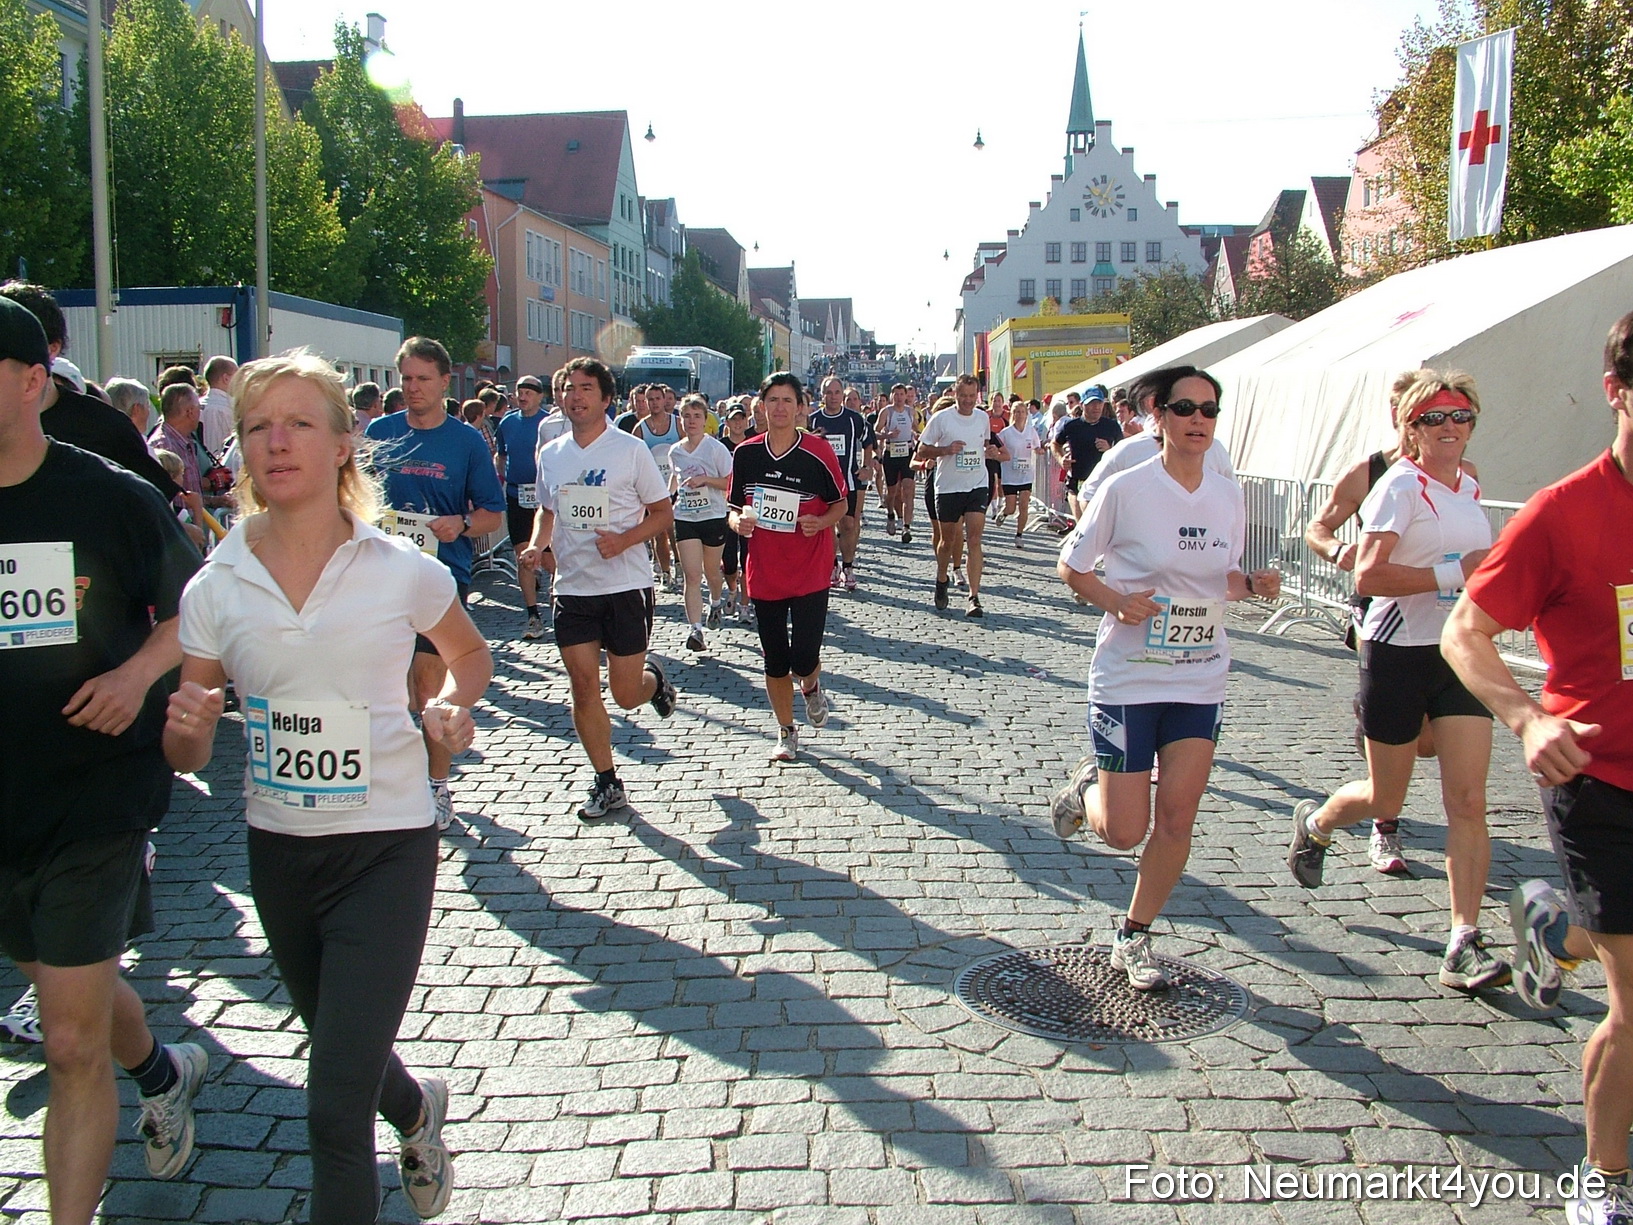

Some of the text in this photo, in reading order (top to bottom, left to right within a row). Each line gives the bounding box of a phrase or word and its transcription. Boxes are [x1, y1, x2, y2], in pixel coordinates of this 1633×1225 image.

[687, 498, 709, 508] 2323
[764, 493, 778, 502] Irmi
[571, 505, 603, 518] 3601
[763, 506, 794, 522] 2870
[397, 516, 417, 527] Marc
[1178, 540, 1207, 551] OMV
[1170, 604, 1207, 617] Kerstin
[1153, 620, 1162, 630] C
[26, 627, 74, 640] PFLEIDERER
[1168, 625, 1215, 643] 2734
[272, 711, 322, 735] Helga
[254, 736, 265, 752] B
[275, 747, 362, 781] 2605
[317, 793, 368, 804] PFLEIDERER
